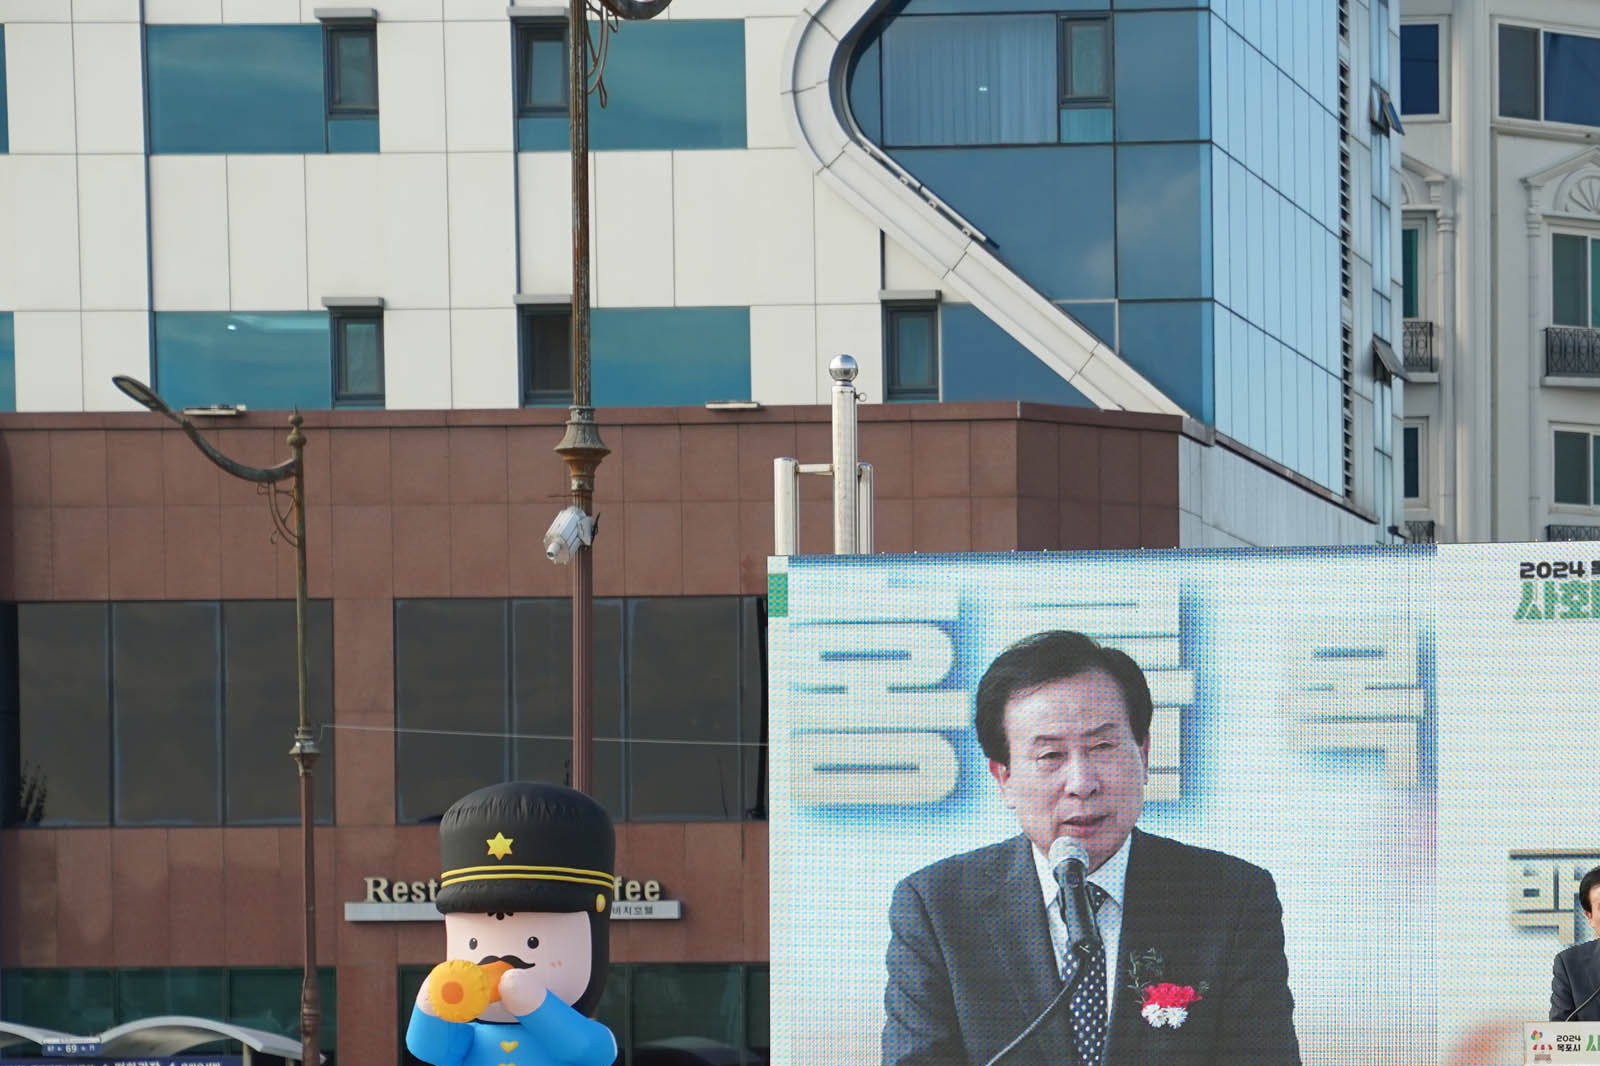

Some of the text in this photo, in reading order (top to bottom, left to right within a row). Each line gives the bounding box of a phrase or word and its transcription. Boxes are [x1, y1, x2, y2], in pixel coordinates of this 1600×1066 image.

[1519, 561, 1586, 579] 2024
[364, 875, 661, 904] Rest fee
[1556, 1035, 1582, 1043] 2024
[1557, 1043, 1582, 1053] 목포시
